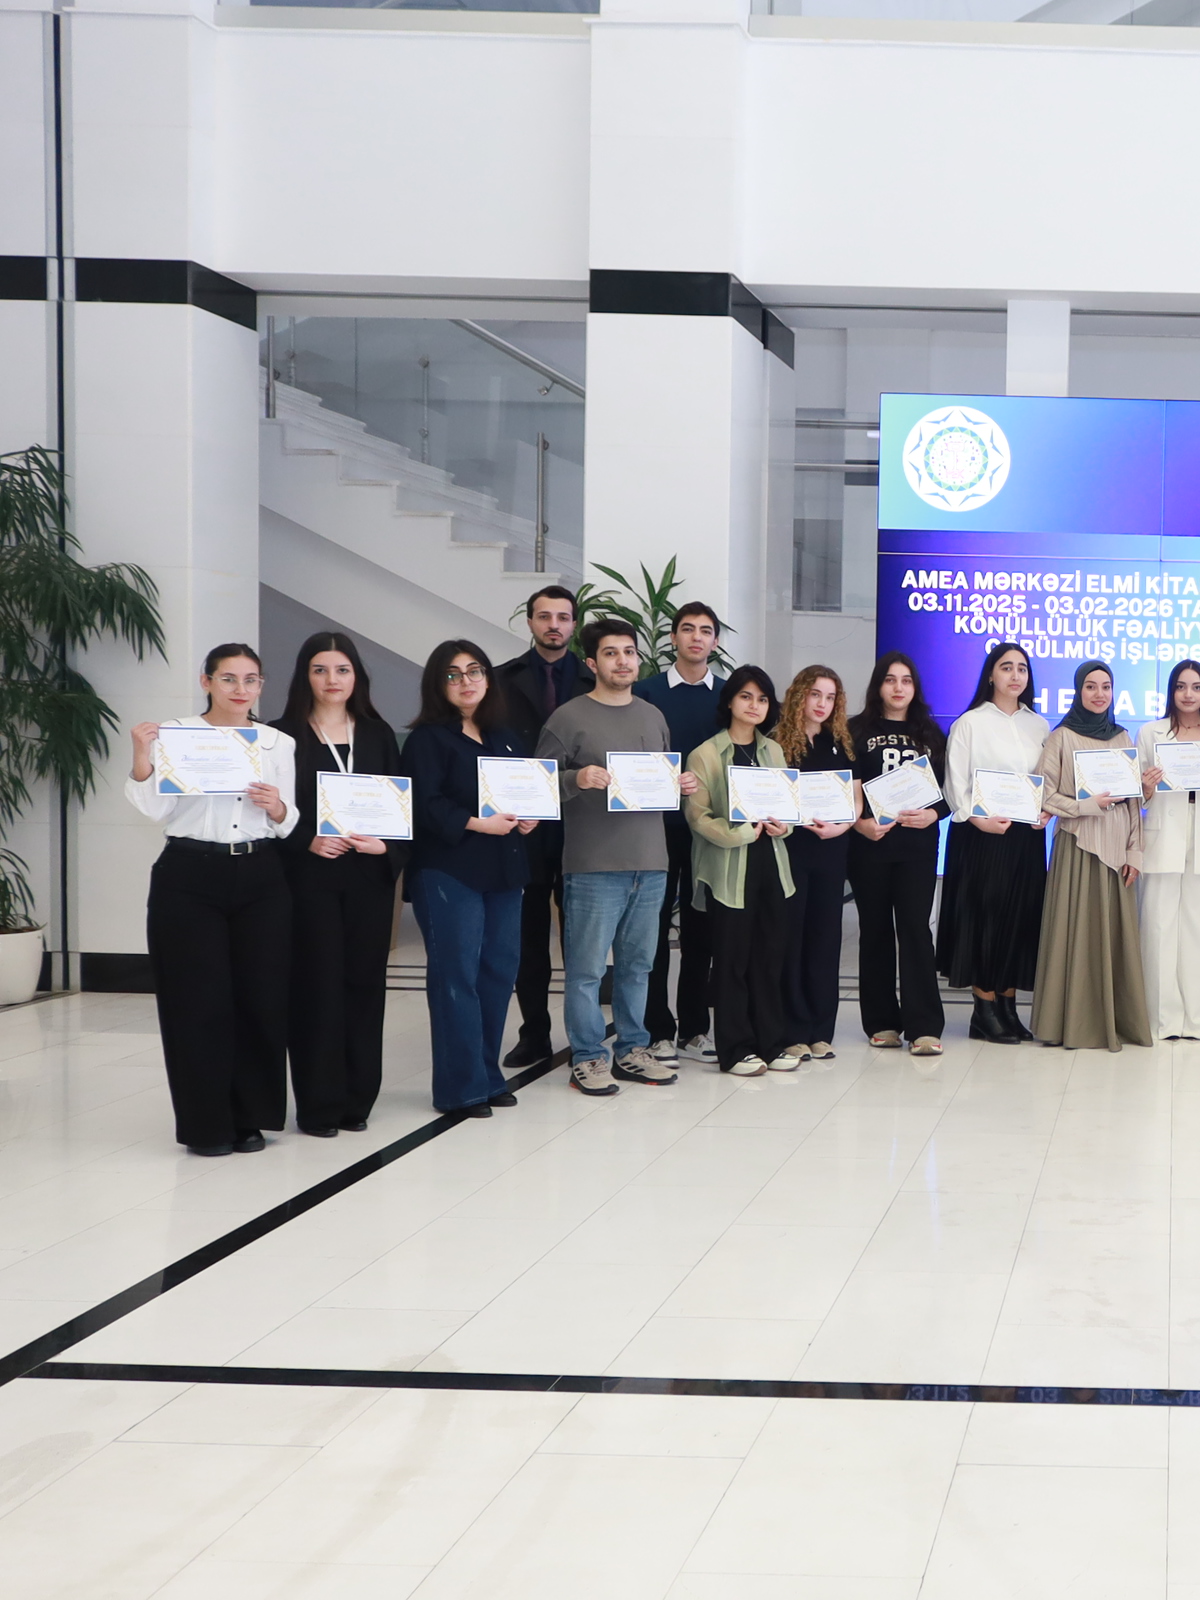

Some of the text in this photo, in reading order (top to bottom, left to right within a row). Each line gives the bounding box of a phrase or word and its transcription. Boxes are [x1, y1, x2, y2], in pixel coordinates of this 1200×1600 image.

[901, 569, 969, 590] AMEA
[974, 569, 1081, 592] MƏRKƏZİ
[1086, 571, 1140, 594] ELMİ
[908, 591, 1027, 614] 03.11.2025
[1044, 595, 1174, 618] 03.02.2026
[954, 611, 1108, 637] KÖNÜLLÜLÜK
